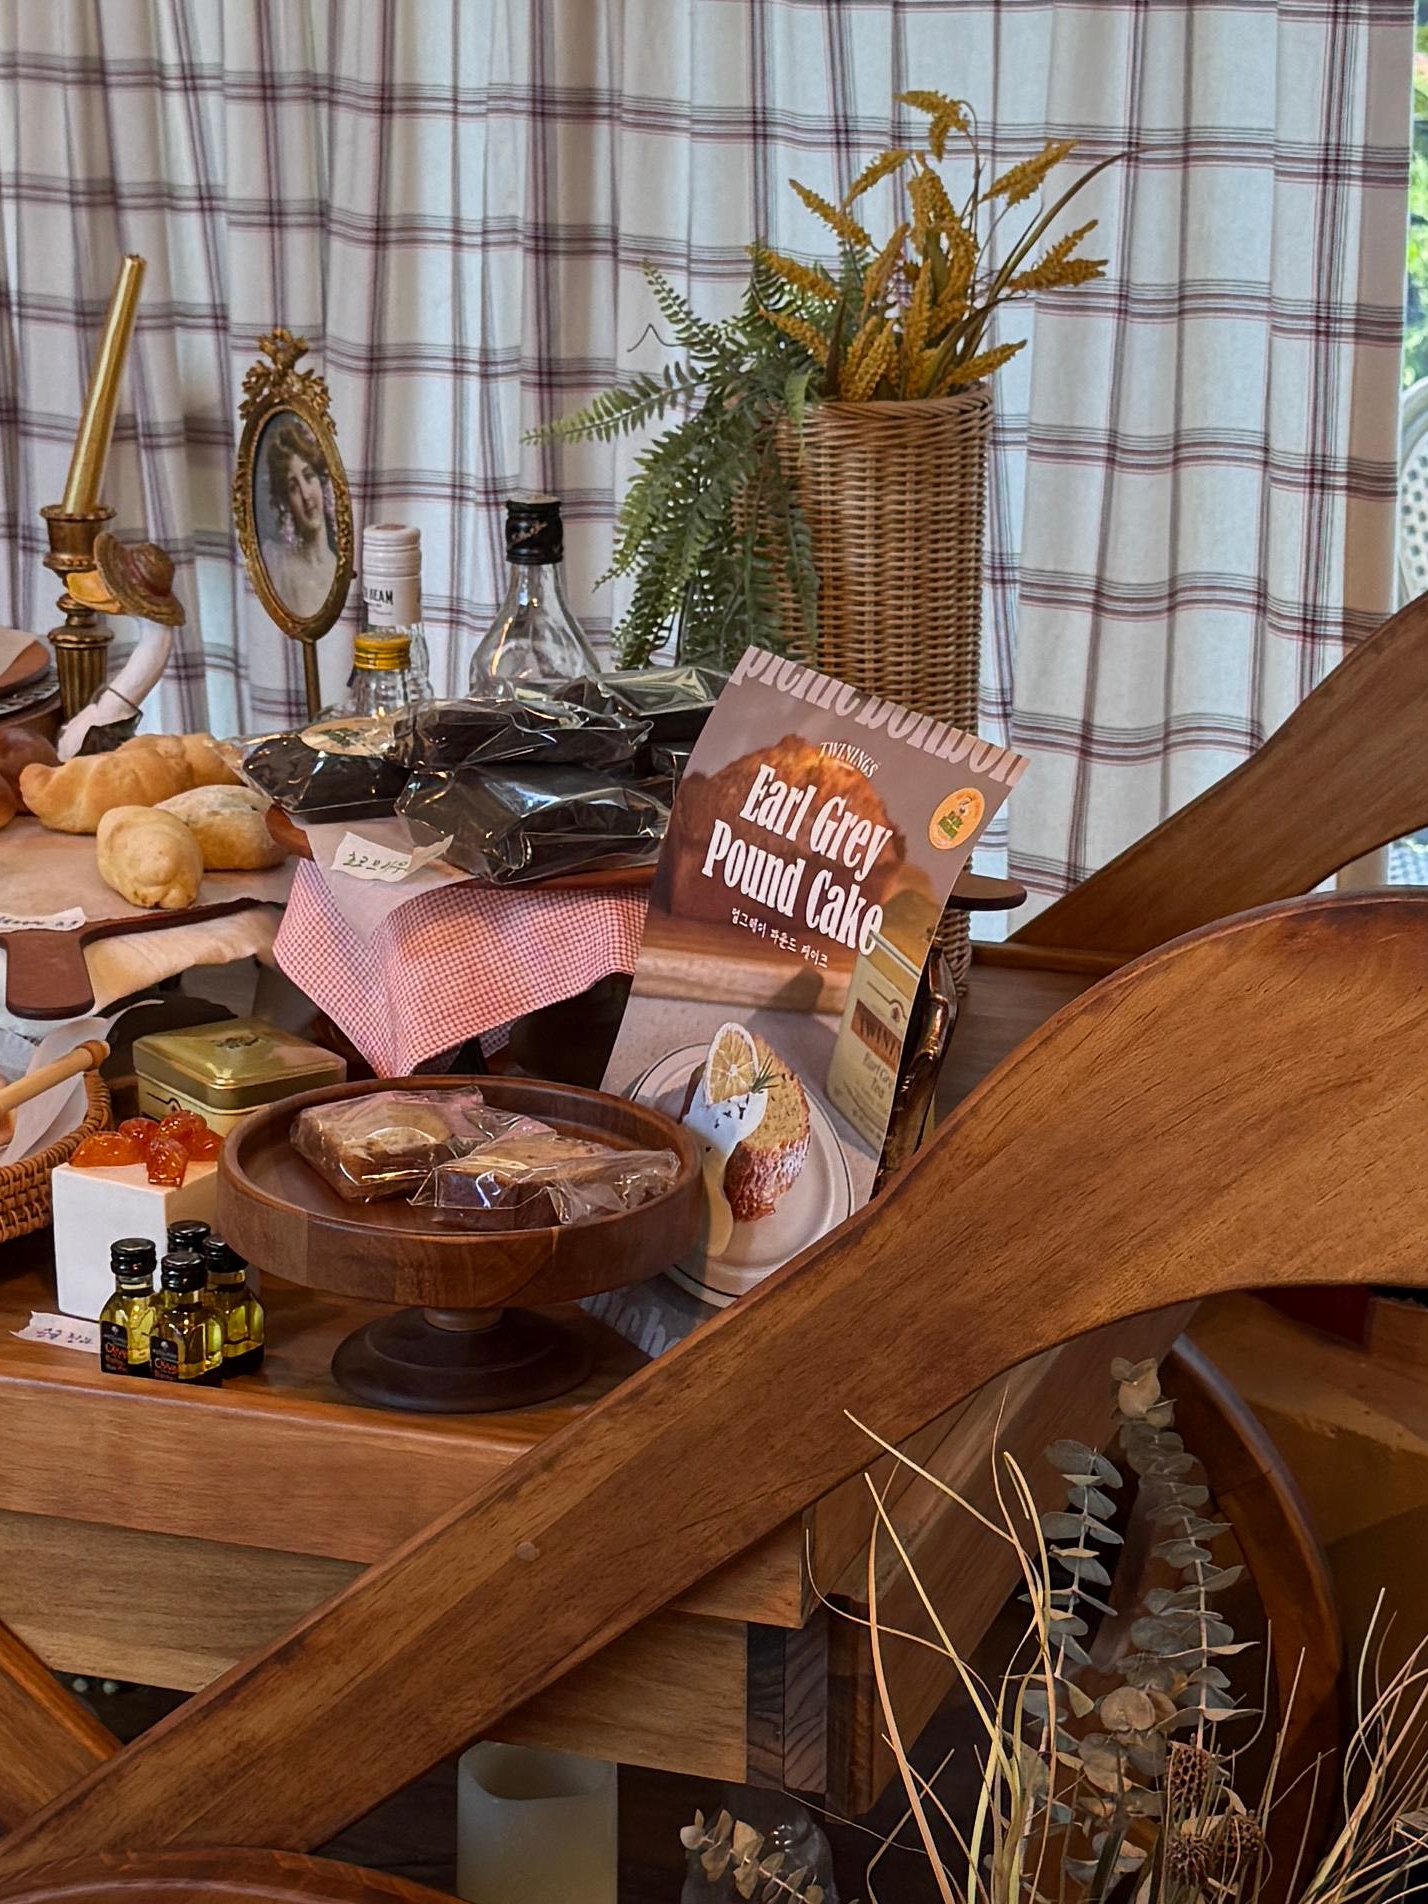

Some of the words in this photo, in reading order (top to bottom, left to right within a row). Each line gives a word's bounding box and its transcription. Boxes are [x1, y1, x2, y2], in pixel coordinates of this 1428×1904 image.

[820, 741, 880, 778] TWININGS
[739, 763, 817, 843] Earl
[809, 795, 893, 882] Grey
[701, 819, 807, 918] Pound
[805, 869, 884, 956] Cake
[769, 929, 798, 953] 파운드
[800, 944, 828, 969] 케이크
